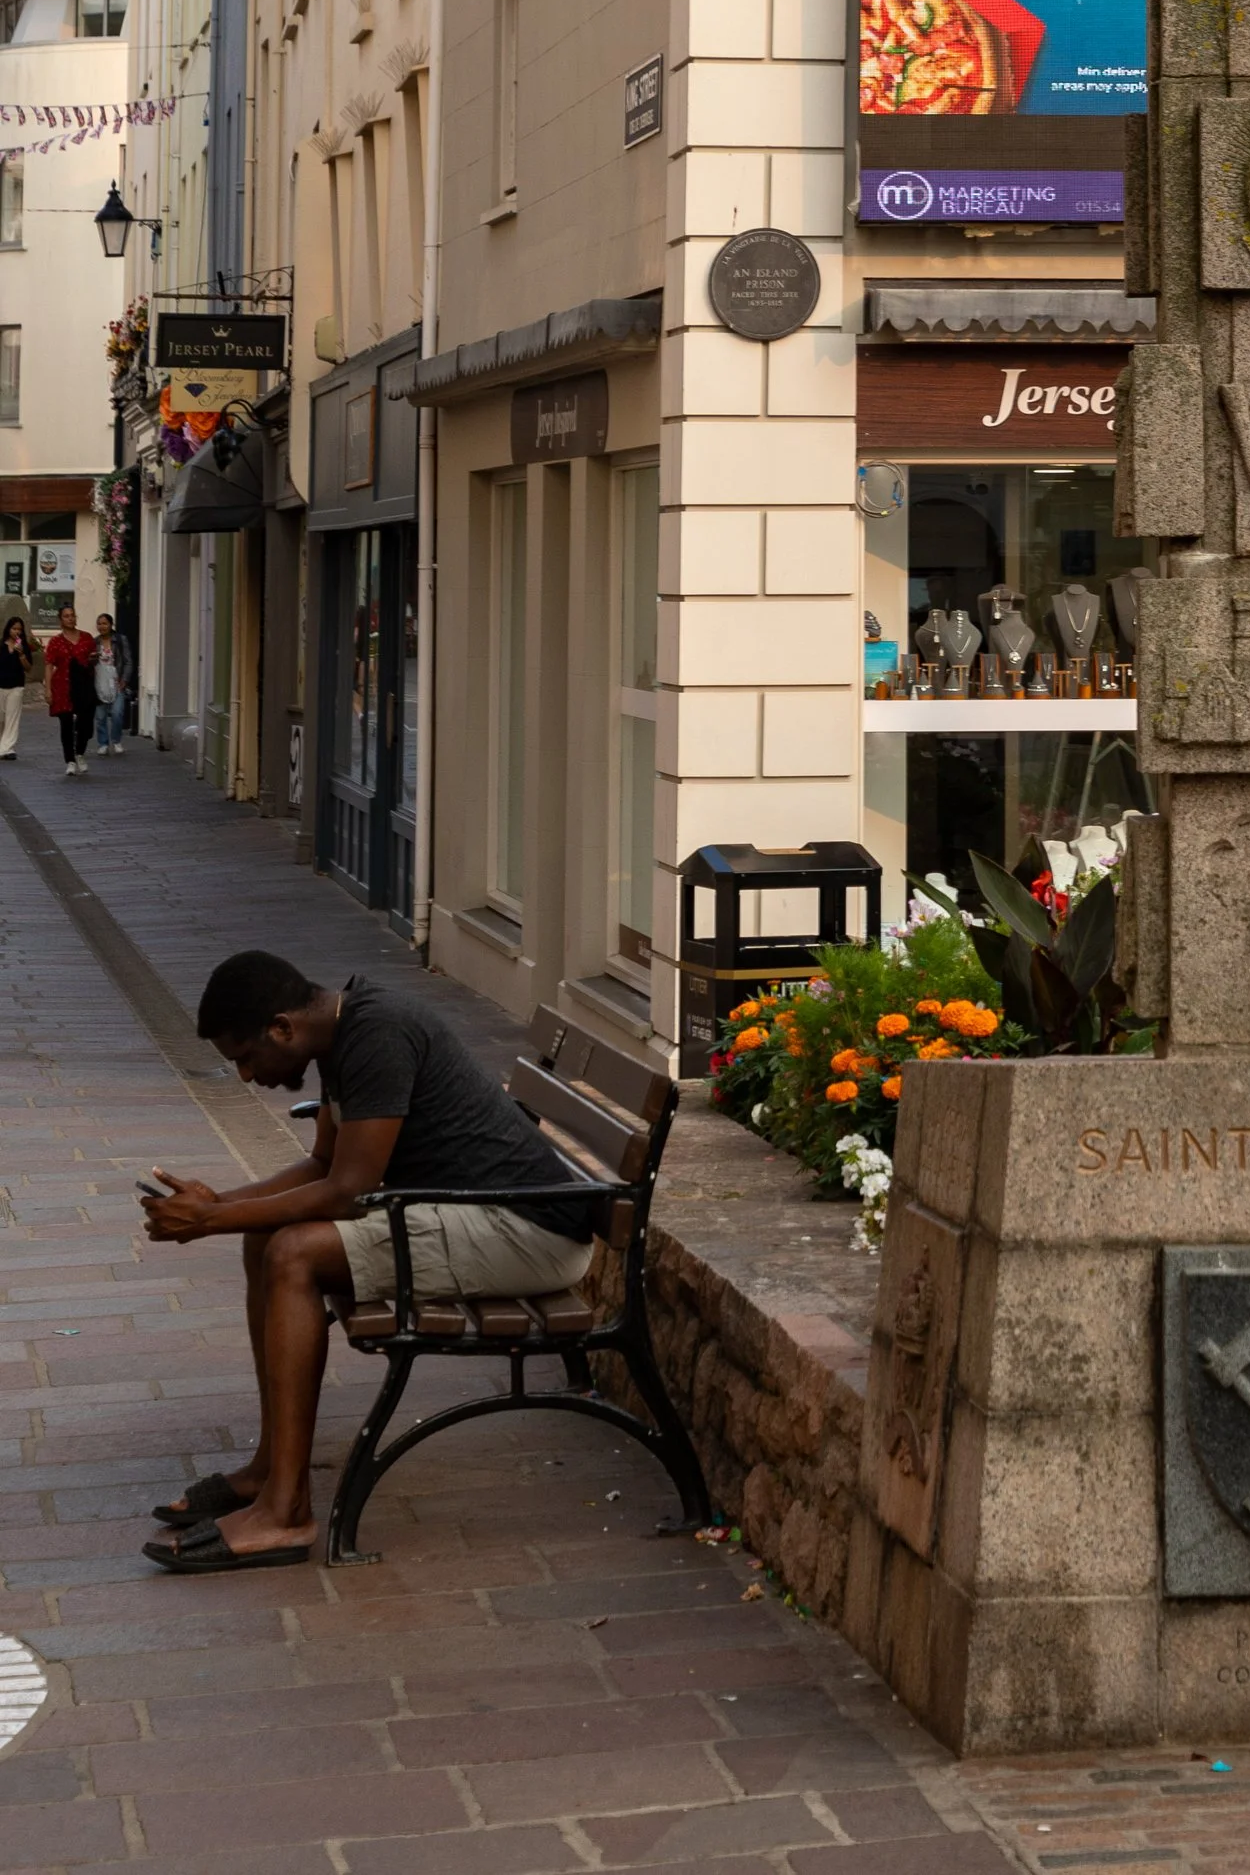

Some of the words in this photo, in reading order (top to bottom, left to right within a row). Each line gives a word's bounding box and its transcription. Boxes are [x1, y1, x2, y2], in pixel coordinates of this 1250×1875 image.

[1077, 66, 1101, 76] Min
[1051, 82, 1085, 92] areas
[1086, 82, 1113, 94] may
[938, 186, 1056, 202] MARKETING
[942, 200, 1024, 215] BUREAU
[1075, 201, 1121, 212] 01534
[733, 269, 750, 278] AN
[756, 268, 799, 278] ISLAND
[746, 280, 785, 289] PRISON
[168, 341, 220, 357] JERSEY
[224, 342, 274, 357] PEARL
[982, 368, 1116, 431] Jerse
